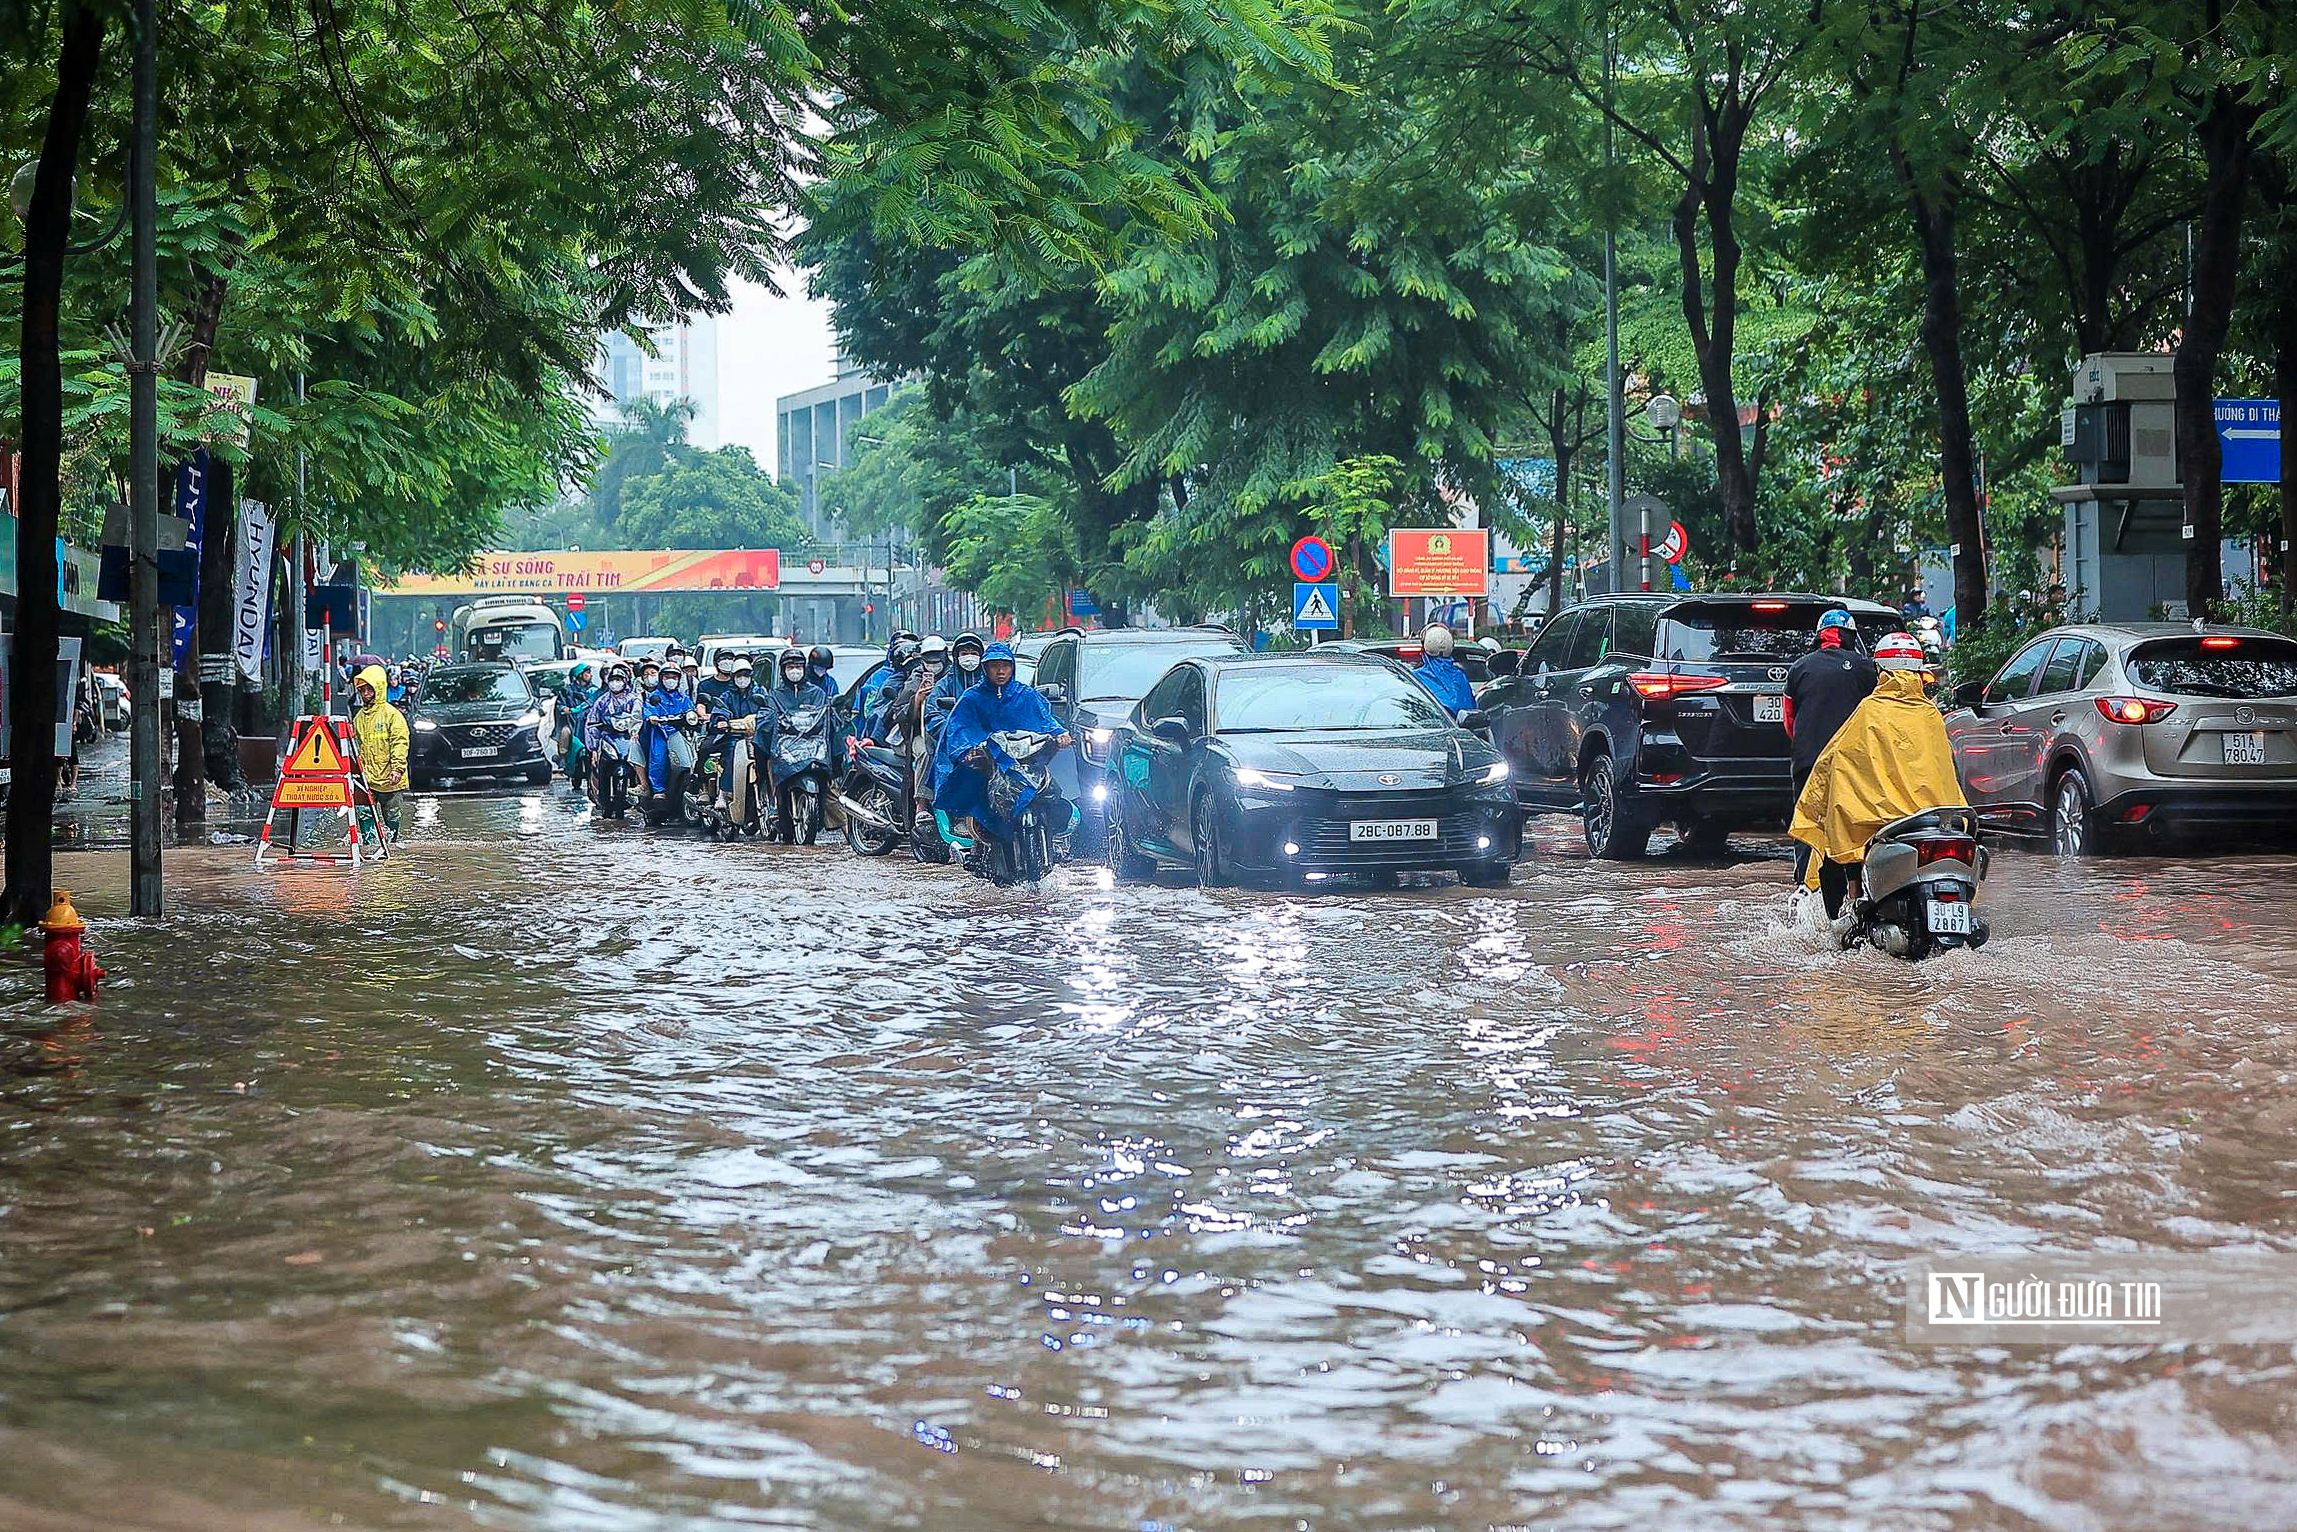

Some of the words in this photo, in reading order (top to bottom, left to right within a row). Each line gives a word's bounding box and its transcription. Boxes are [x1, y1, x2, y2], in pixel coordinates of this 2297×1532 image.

[597, 572, 621, 587] TIM
[238, 521, 264, 660] HYUNDAI
[1767, 697, 1784, 708] 30
[1759, 709, 1784, 720] 420.
[2233, 734, 2255, 748] 51A
[2226, 749, 2263, 762] 780.47
[1358, 824, 1430, 838] 28C-087.88
[1934, 917, 1964, 931] 2887
